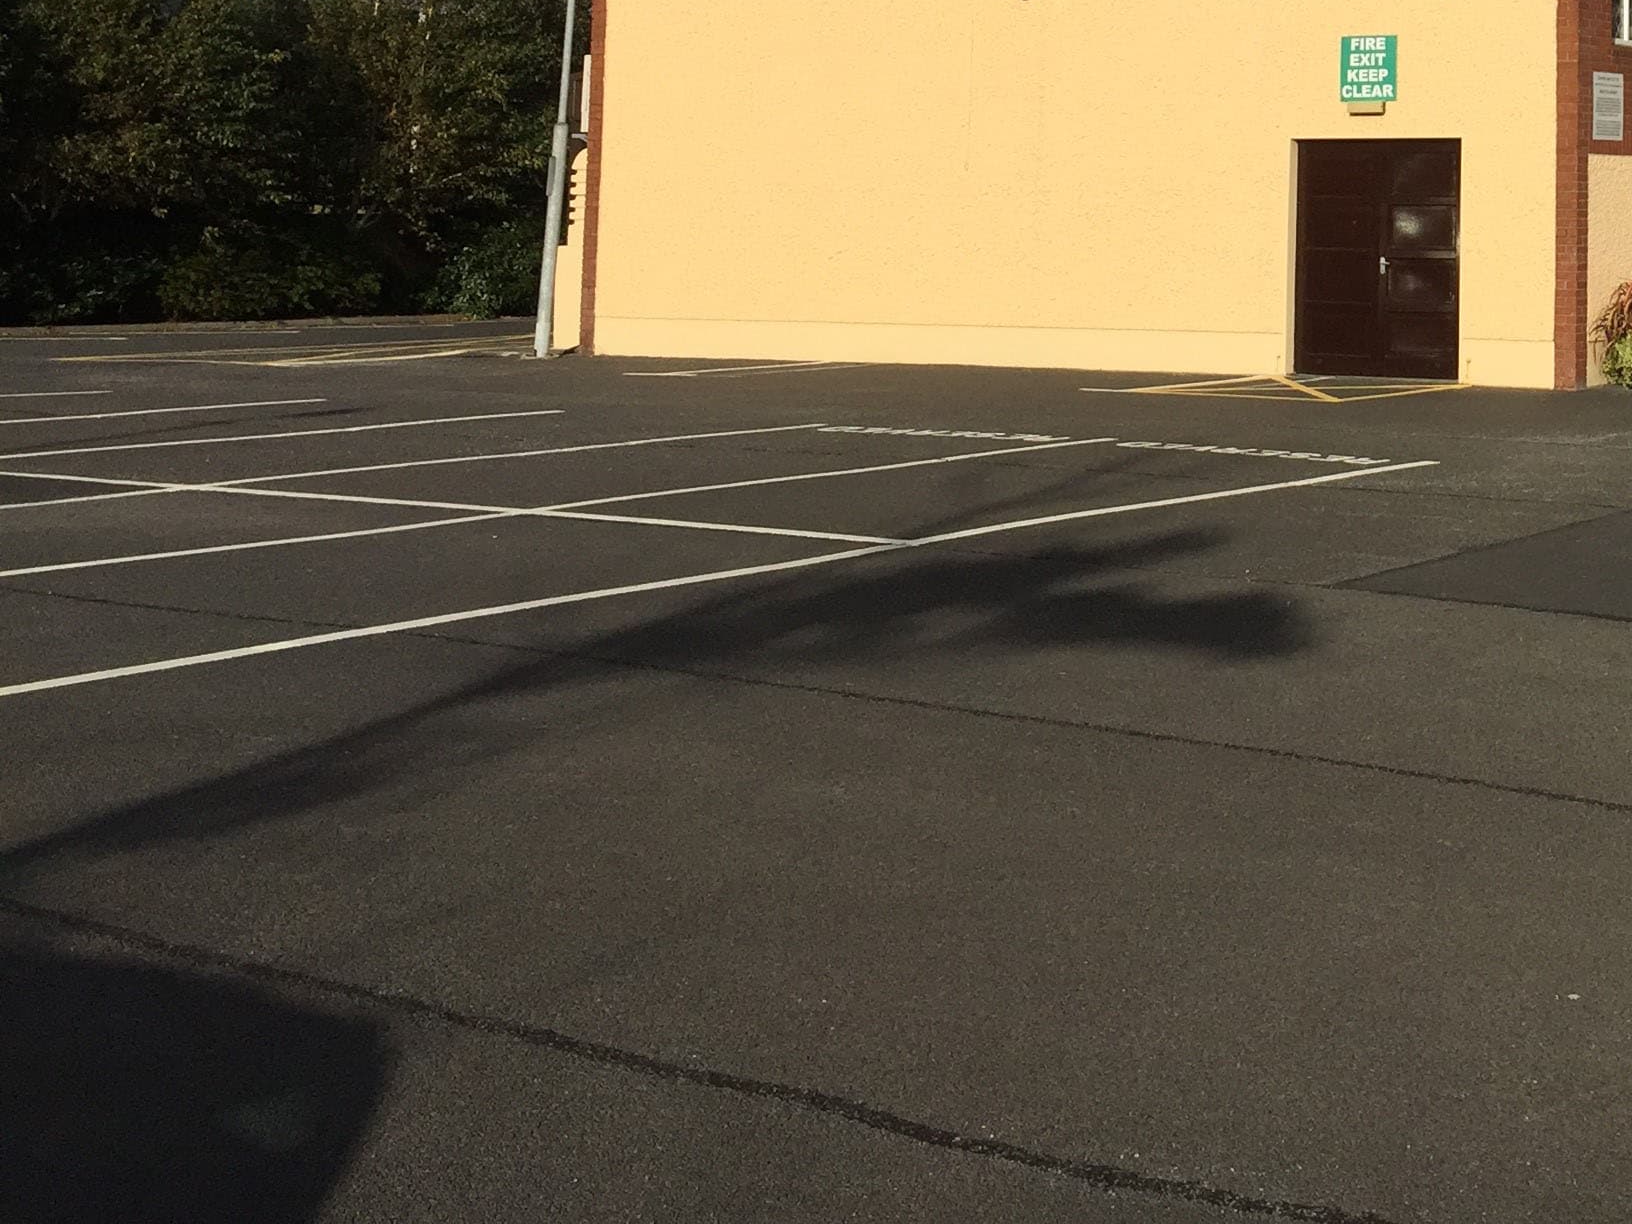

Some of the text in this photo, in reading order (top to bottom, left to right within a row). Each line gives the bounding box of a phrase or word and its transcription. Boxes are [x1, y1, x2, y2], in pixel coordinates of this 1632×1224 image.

[1350, 37, 1386, 51] FIRE
[1349, 53, 1386, 67] EXIT
[1347, 69, 1389, 82] KEEP
[1342, 84, 1394, 98] CLEAR
[817, 425, 1071, 442] RESERVED
[1116, 441, 1391, 465] RESERVED
